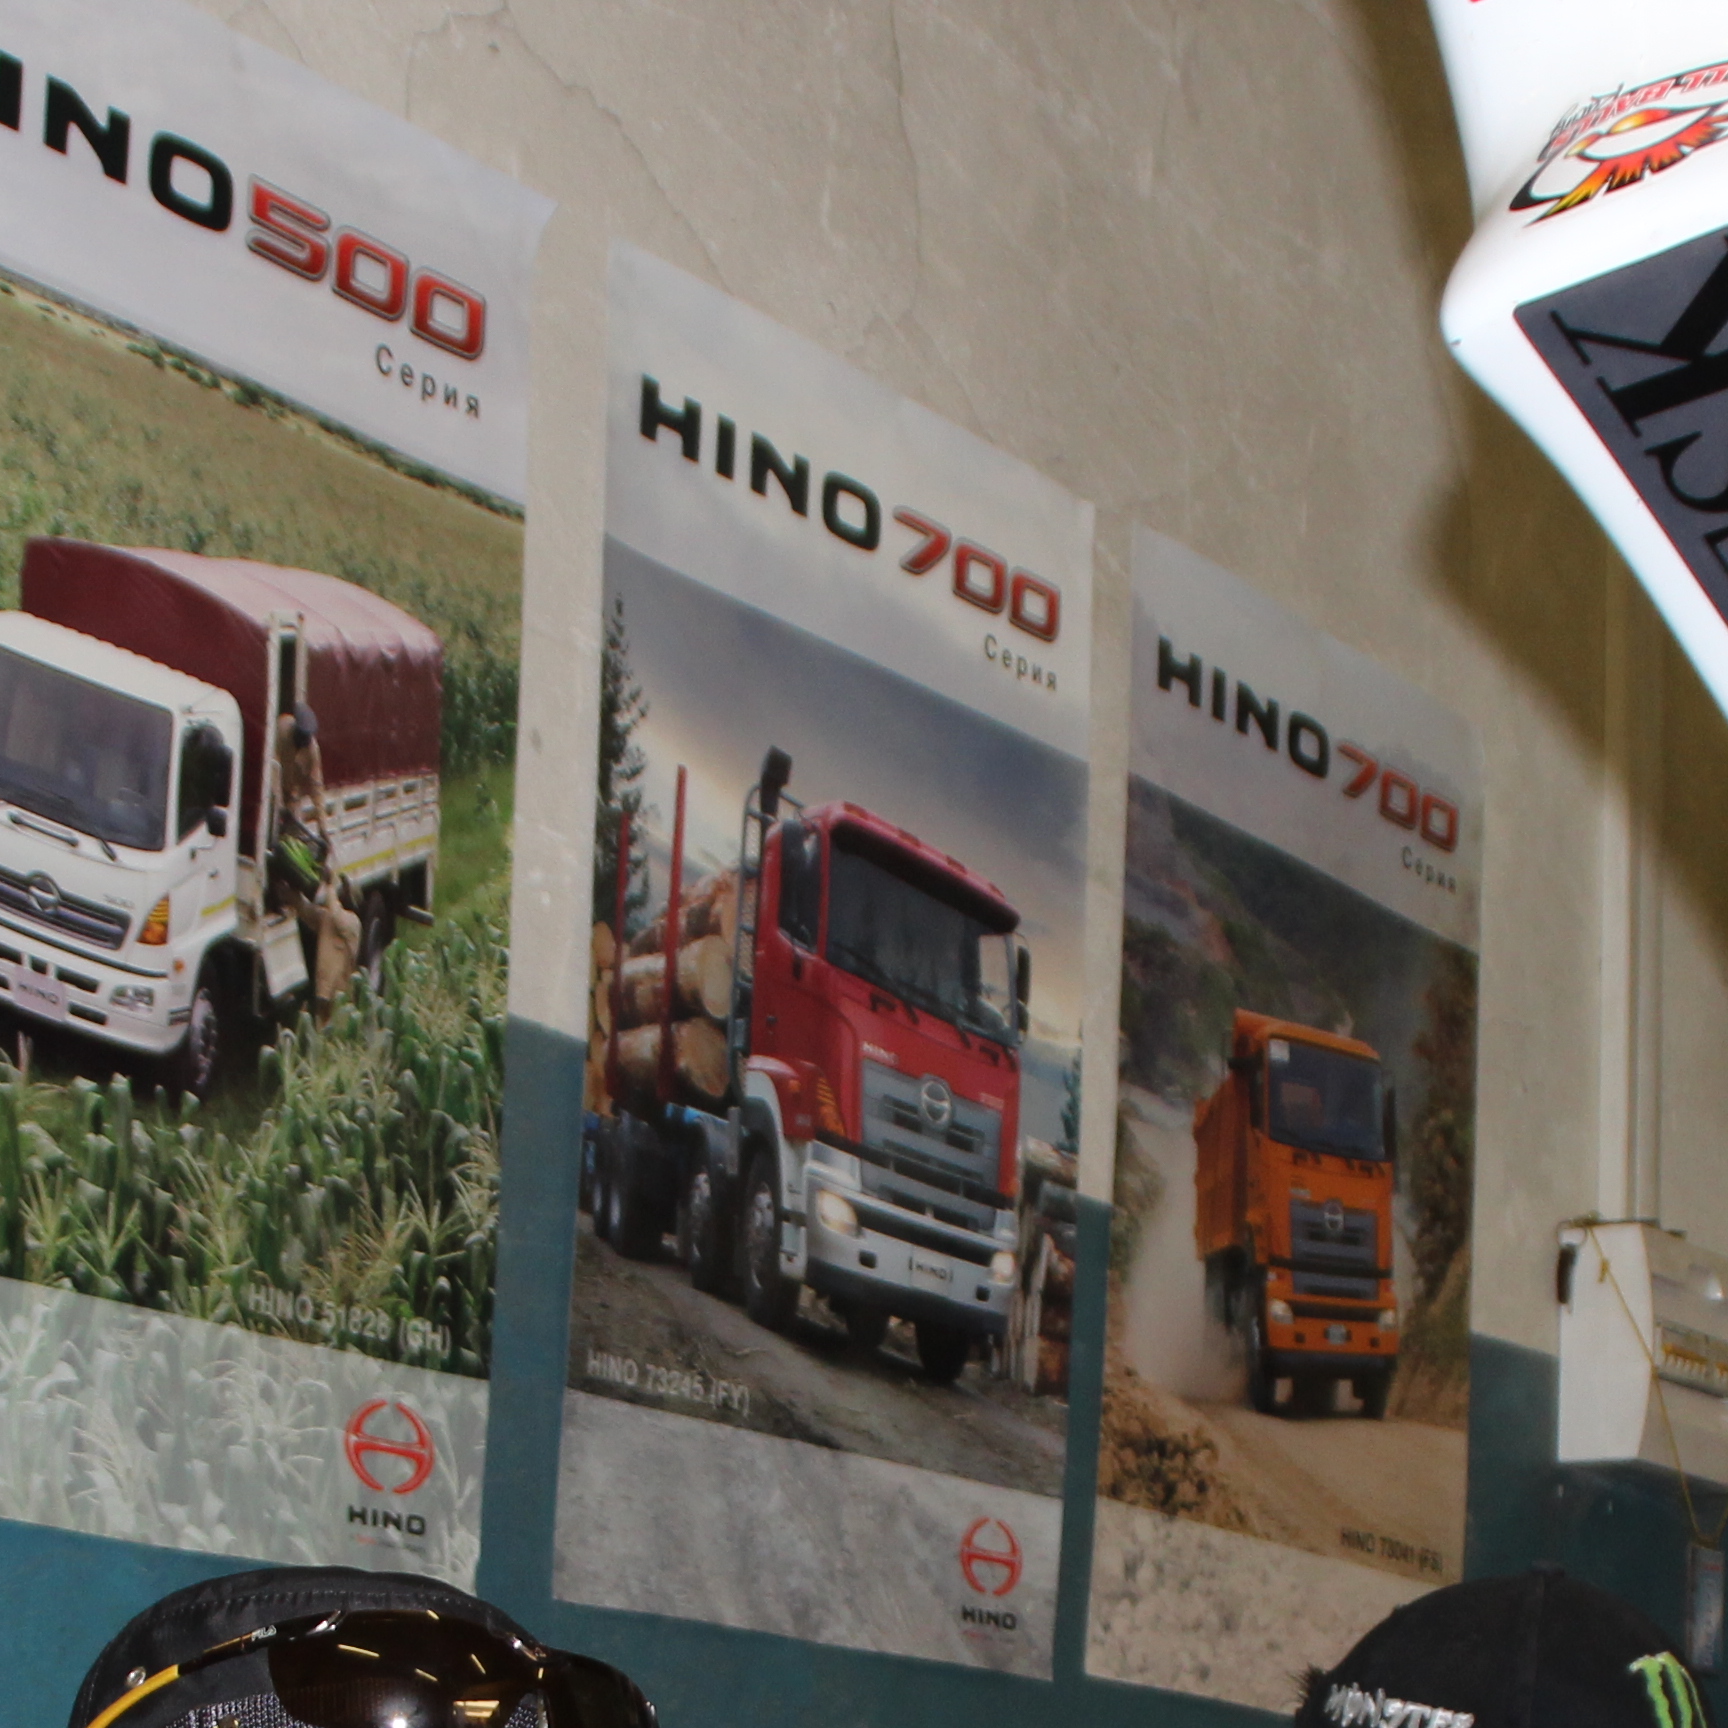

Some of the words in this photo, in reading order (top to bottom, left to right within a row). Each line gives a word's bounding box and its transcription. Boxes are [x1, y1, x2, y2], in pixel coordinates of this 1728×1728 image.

[376, 344, 480, 418] Серия
[984, 634, 1058, 692] Серия
[1400, 845, 1457, 896] Серия
[248, 1283, 314, 1325] HINO
[587, 1348, 640, 1386] HINO
[348, 1505, 426, 1536] HINO
[1341, 1529, 1376, 1554] HINO
[961, 1604, 1017, 1630] HINO
